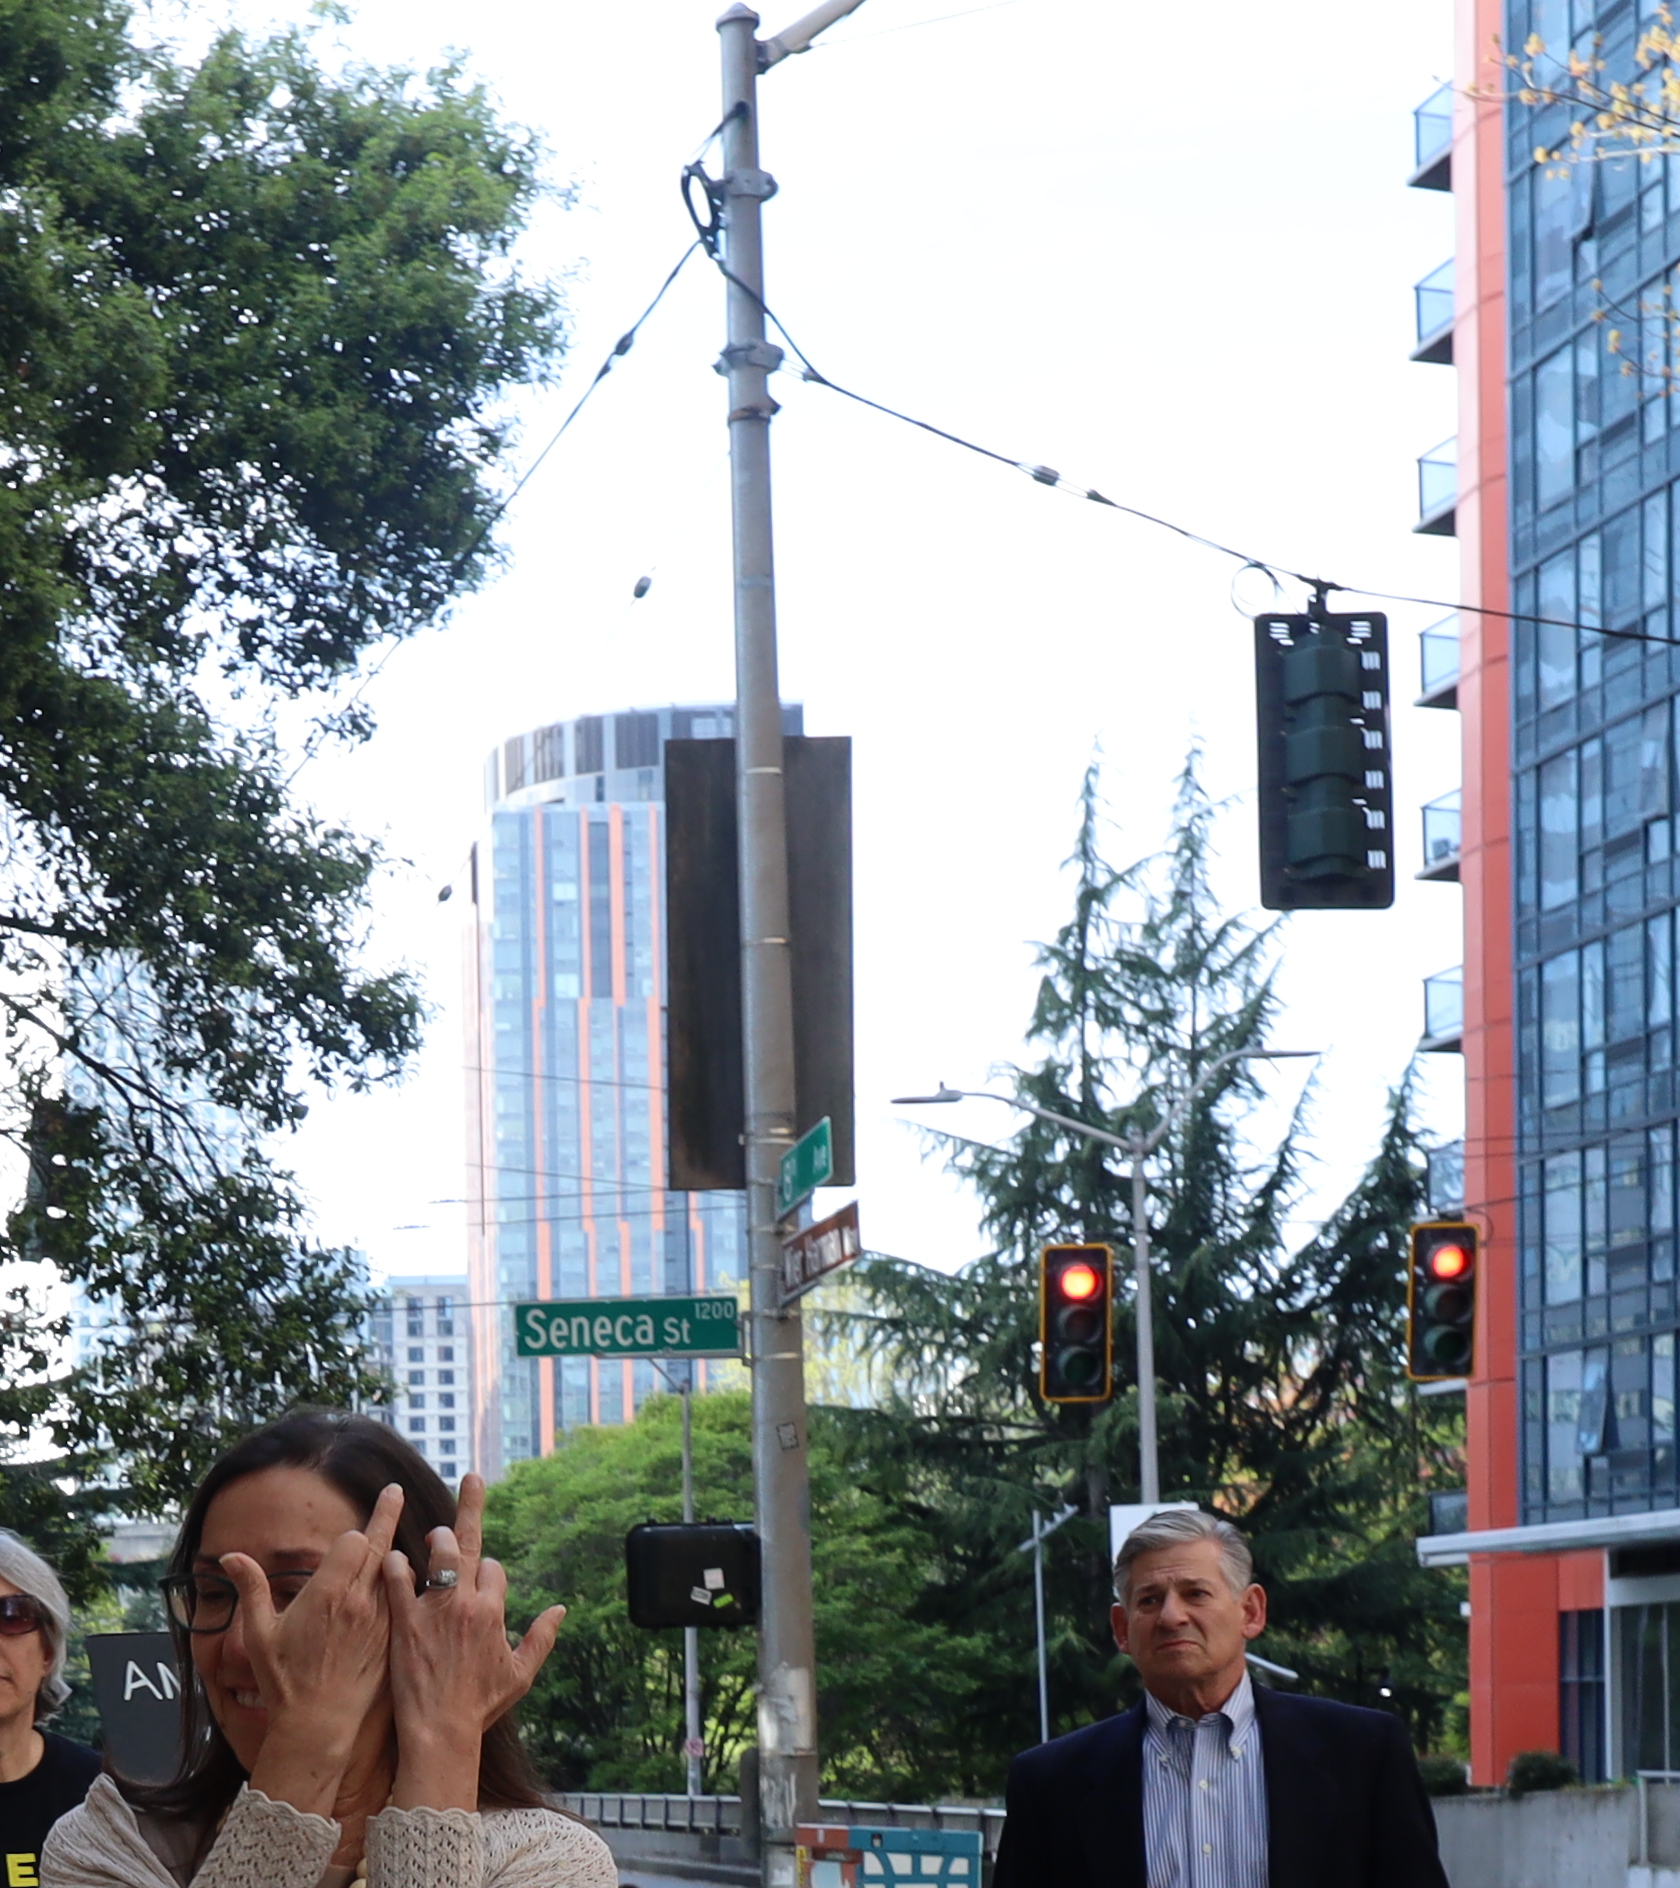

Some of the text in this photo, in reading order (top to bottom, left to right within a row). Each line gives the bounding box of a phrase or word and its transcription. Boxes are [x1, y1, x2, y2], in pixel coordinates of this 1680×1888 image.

[524, 1301, 735, 1349] Seneca St 1200
